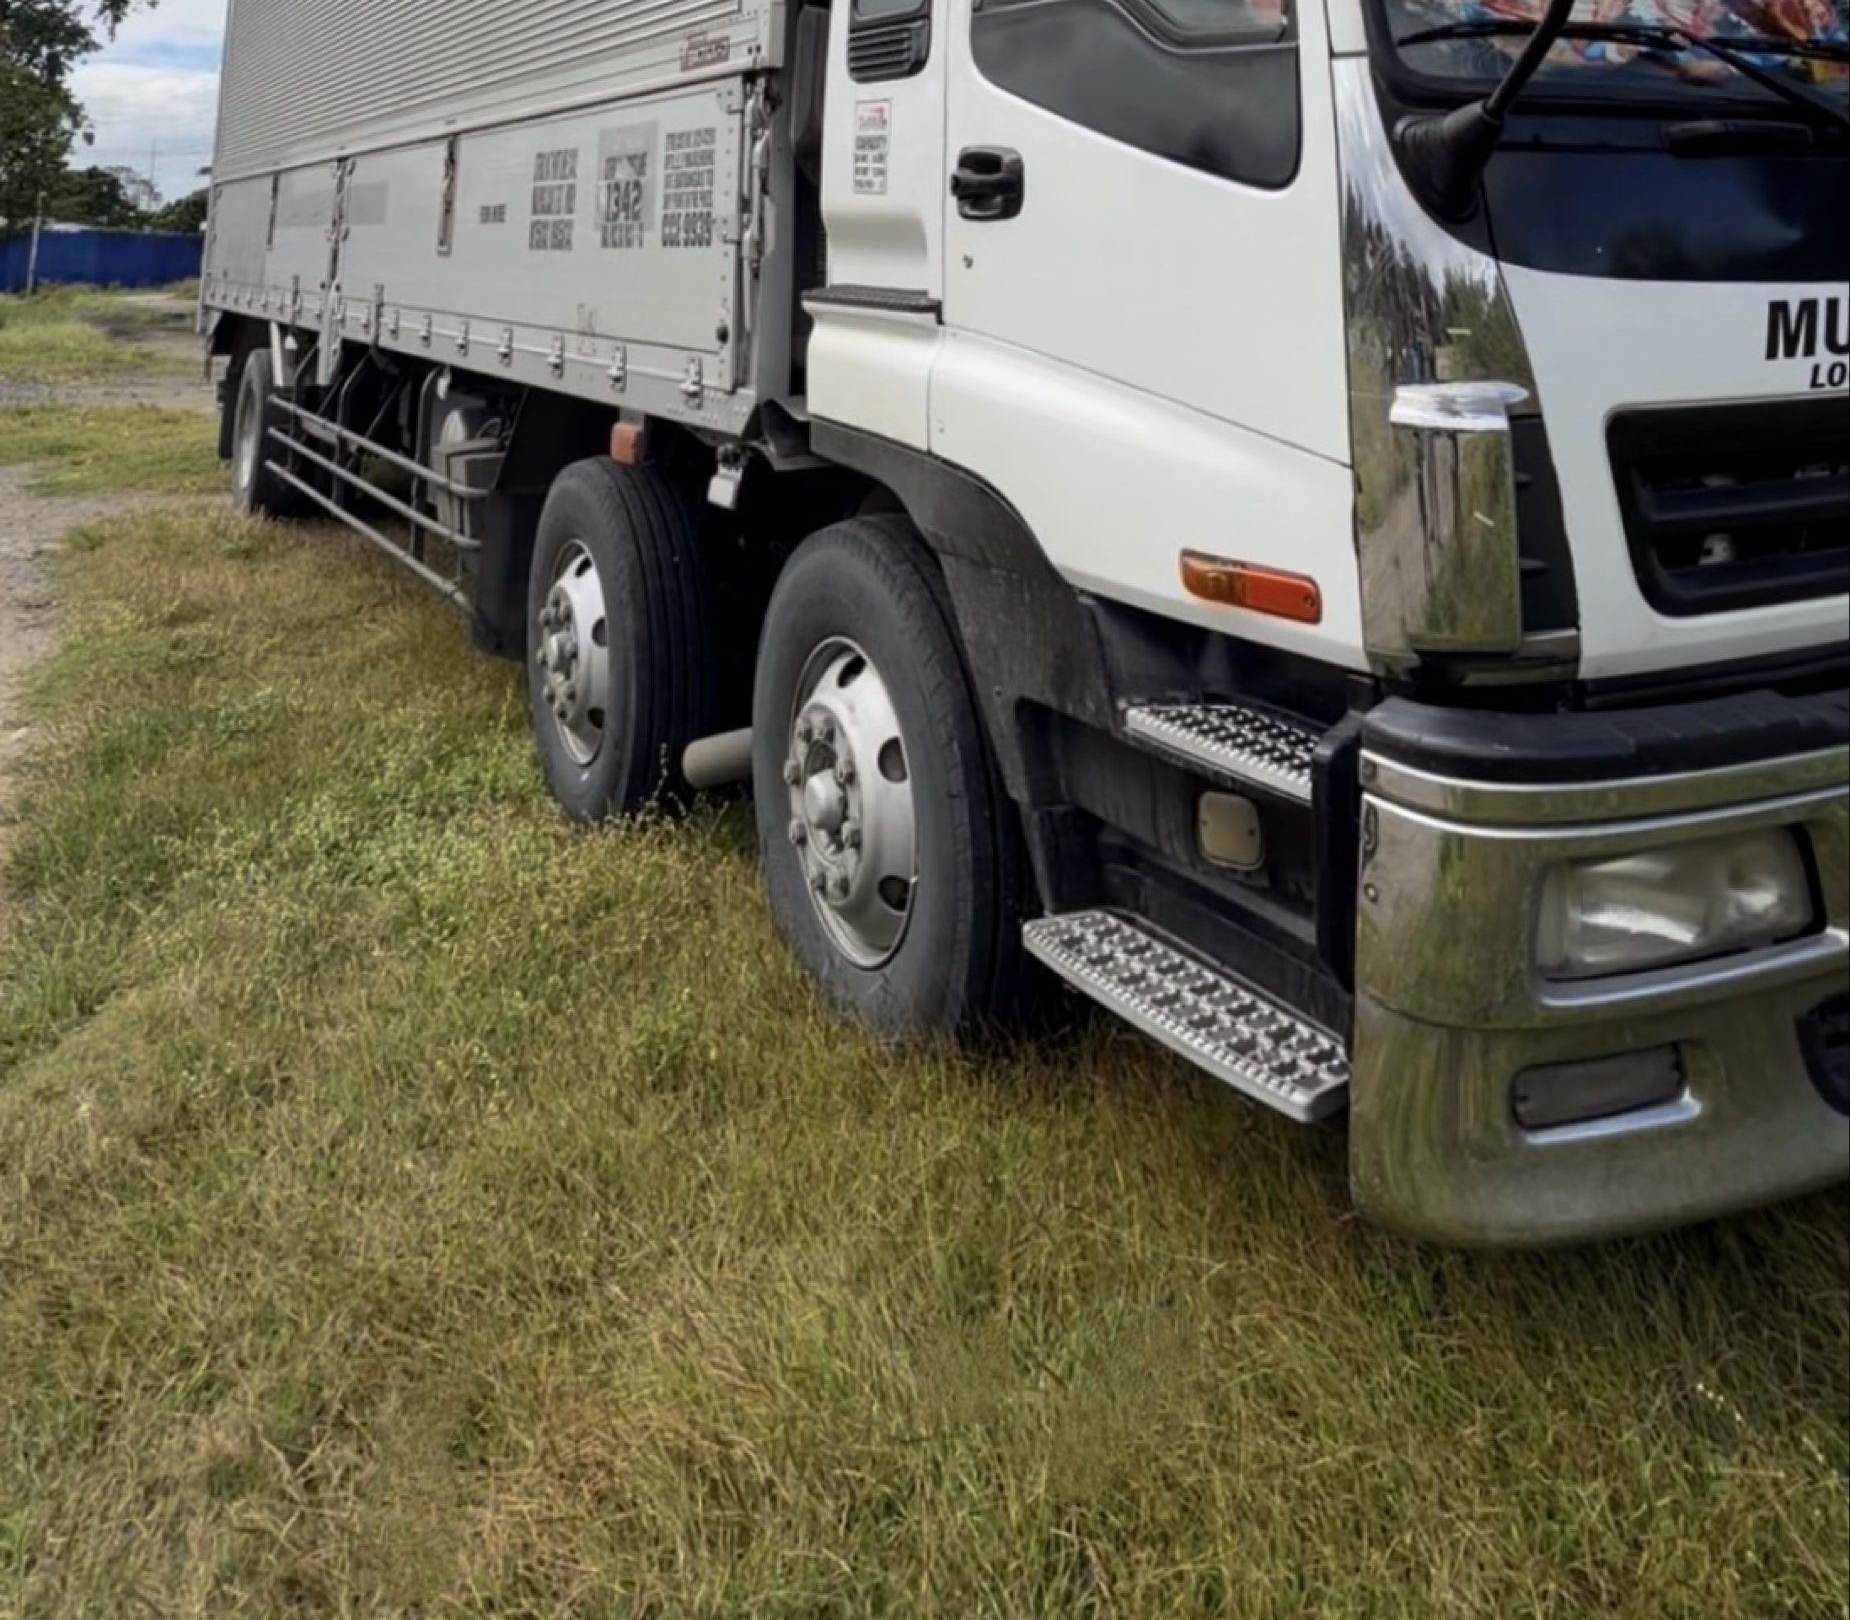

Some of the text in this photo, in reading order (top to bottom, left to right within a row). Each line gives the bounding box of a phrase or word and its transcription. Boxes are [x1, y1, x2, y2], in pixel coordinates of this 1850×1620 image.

[605, 179, 643, 221] 1342
[1765, 297, 1849, 360] MU
[1809, 361, 1848, 388] LO
